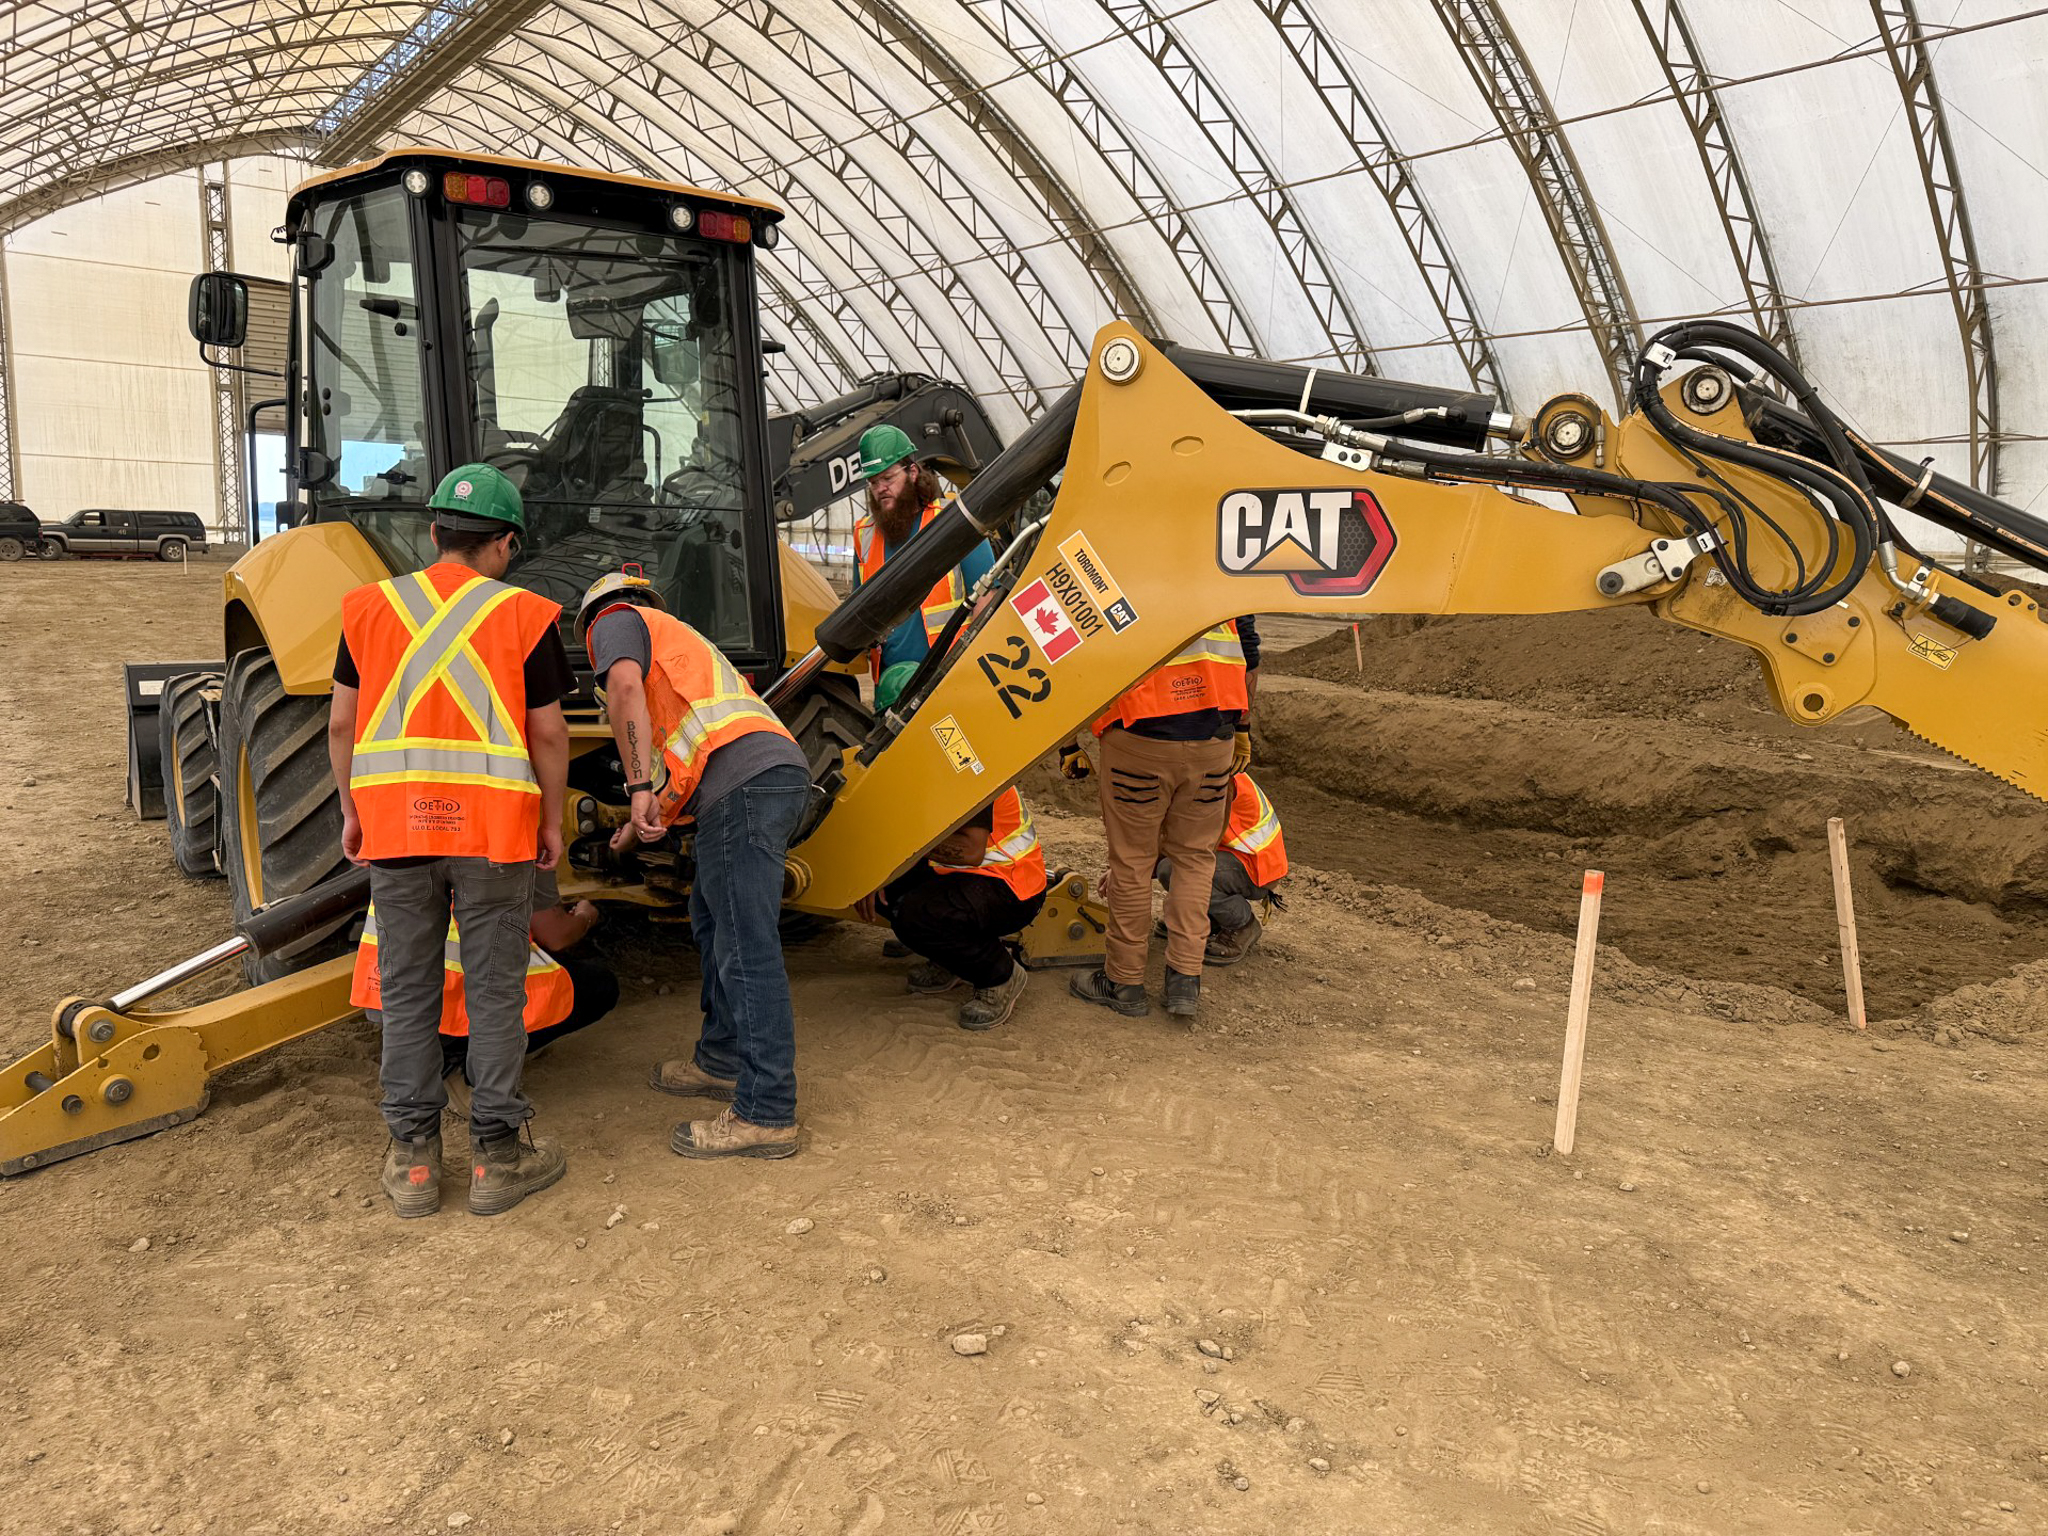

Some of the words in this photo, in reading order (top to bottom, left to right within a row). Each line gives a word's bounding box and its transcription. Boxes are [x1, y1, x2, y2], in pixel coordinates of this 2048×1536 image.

[828, 451, 863, 494] DE
[1221, 491, 1353, 571] CAT
[1045, 562, 1104, 637] H9X01001
[1074, 548, 1109, 594] TOROMONT
[1109, 603, 1132, 626] CAT
[977, 635, 1052, 720] 22
